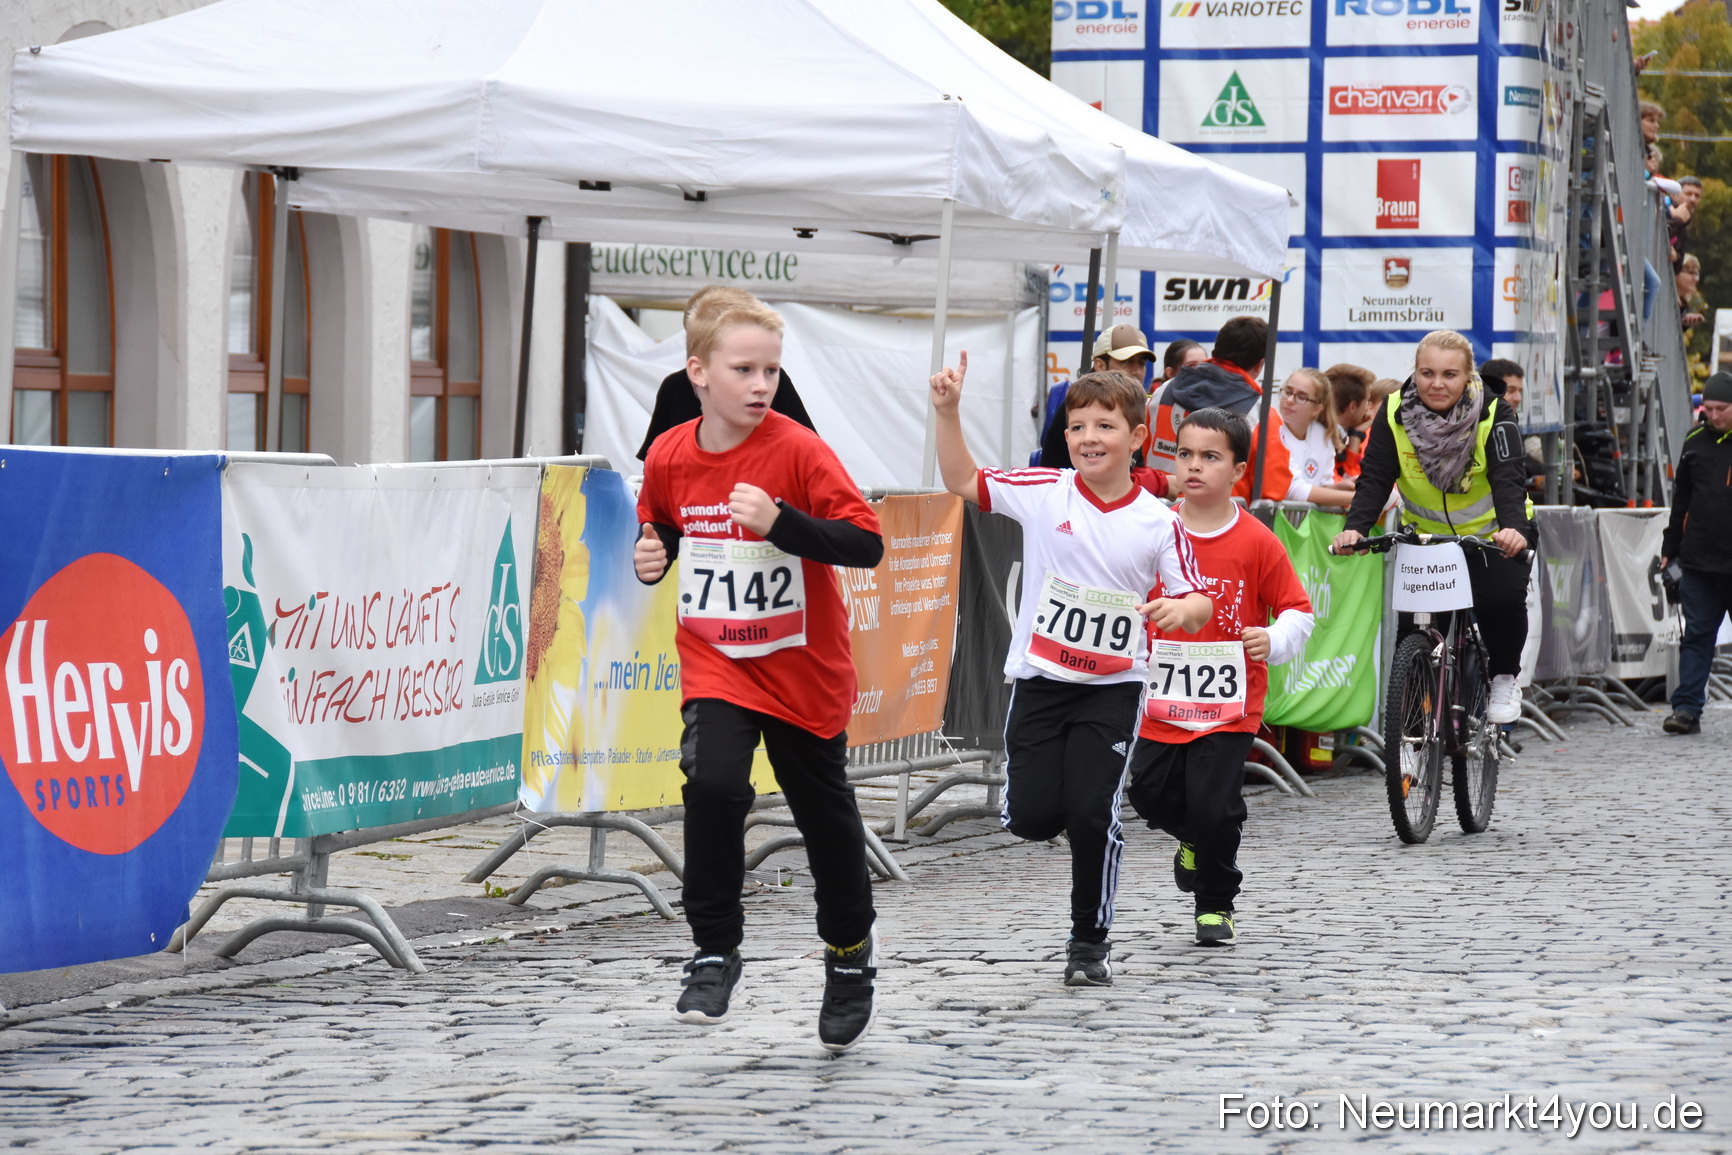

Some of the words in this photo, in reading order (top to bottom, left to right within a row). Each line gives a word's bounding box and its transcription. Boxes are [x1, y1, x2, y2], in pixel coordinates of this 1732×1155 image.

[1206, 0, 1304, 17] VARIOTEC
[1076, 17, 1138, 34] energie
[1407, 10, 1470, 30] energie
[1334, 85, 1433, 108] charivari
[1376, 197, 1416, 217] Braun
[1163, 278, 1251, 301] swn
[1162, 302, 1220, 312] stadtwerke
[1222, 302, 1269, 312] neumark
[1362, 295, 1433, 307] Neumarkter
[1348, 307, 1445, 323] Lammsbräu
[1401, 563, 1424, 575] Erster
[1427, 563, 1458, 574] Mann
[693, 566, 794, 612] 7142
[1402, 578, 1456, 594] Jugendlauf
[1085, 590, 1135, 607] BOCK
[331, 590, 381, 650] UNS
[1046, 598, 1132, 651] 7019
[719, 624, 768, 641] Justin
[1060, 649, 1097, 671] Dario
[1188, 645, 1236, 656] BOCK
[1158, 662, 1238, 698] 7123
[5, 619, 193, 792] Hervis
[1168, 704, 1222, 722] Raphael
[34, 773, 126, 812] SPORTS
